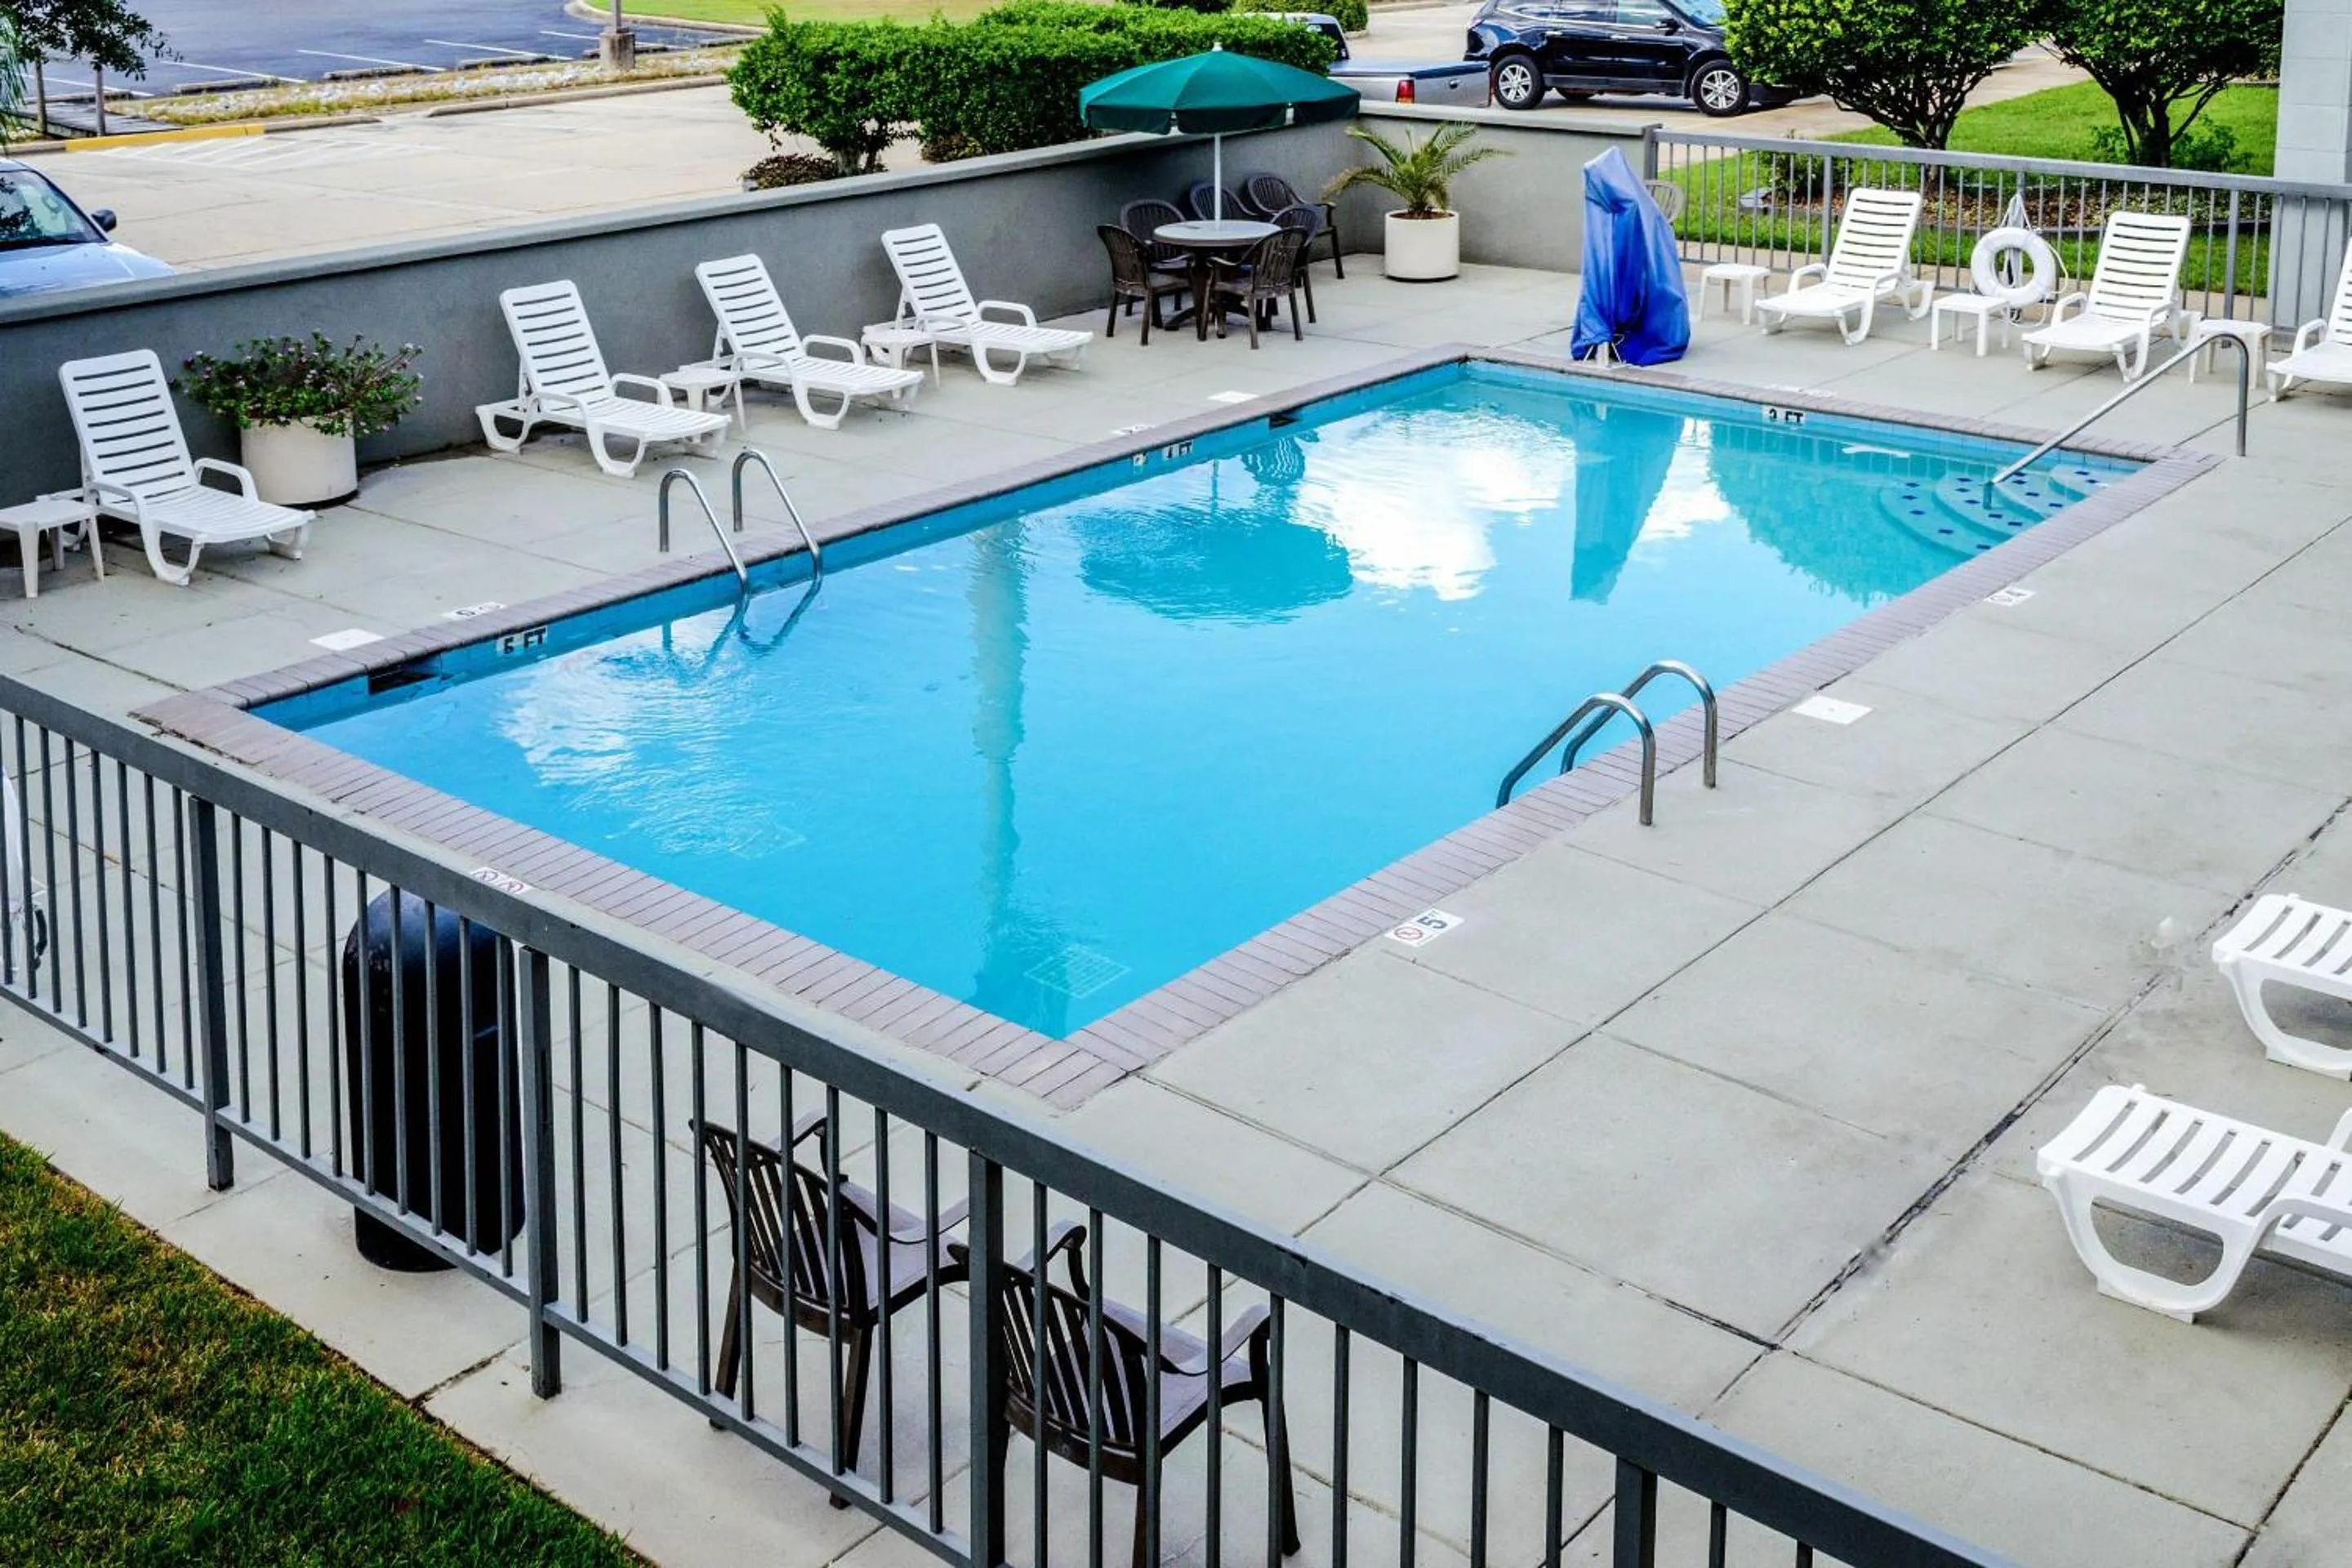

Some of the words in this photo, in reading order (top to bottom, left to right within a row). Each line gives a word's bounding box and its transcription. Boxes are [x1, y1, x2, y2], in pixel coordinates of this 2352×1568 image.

[1785, 411, 1803, 423] FT
[523, 627, 546, 648] FT
[1417, 915, 1448, 929] 5
